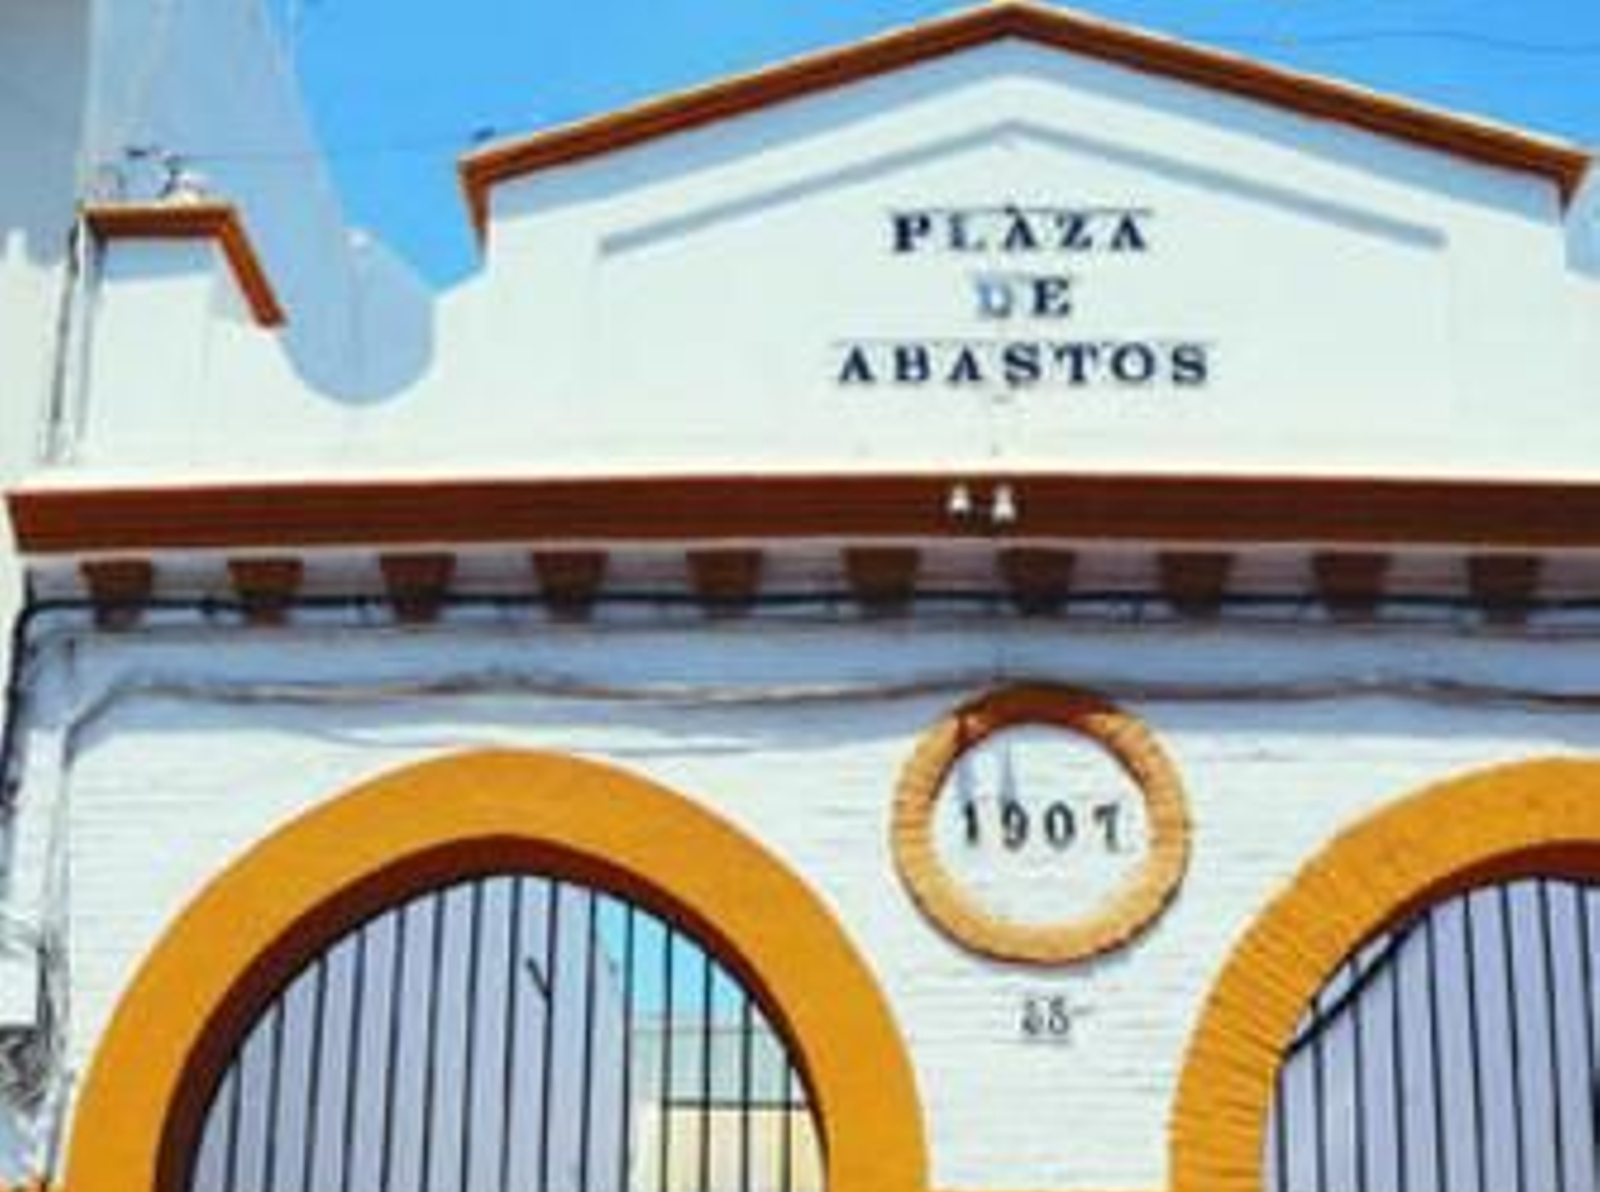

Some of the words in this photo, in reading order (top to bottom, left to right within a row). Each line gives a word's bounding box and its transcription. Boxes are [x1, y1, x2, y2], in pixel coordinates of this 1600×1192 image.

[891, 210, 1148, 252] PLAZA
[976, 276, 1071, 318] DE
[838, 342, 1209, 386] ABASTOS
[963, 800, 1120, 852] 1907
